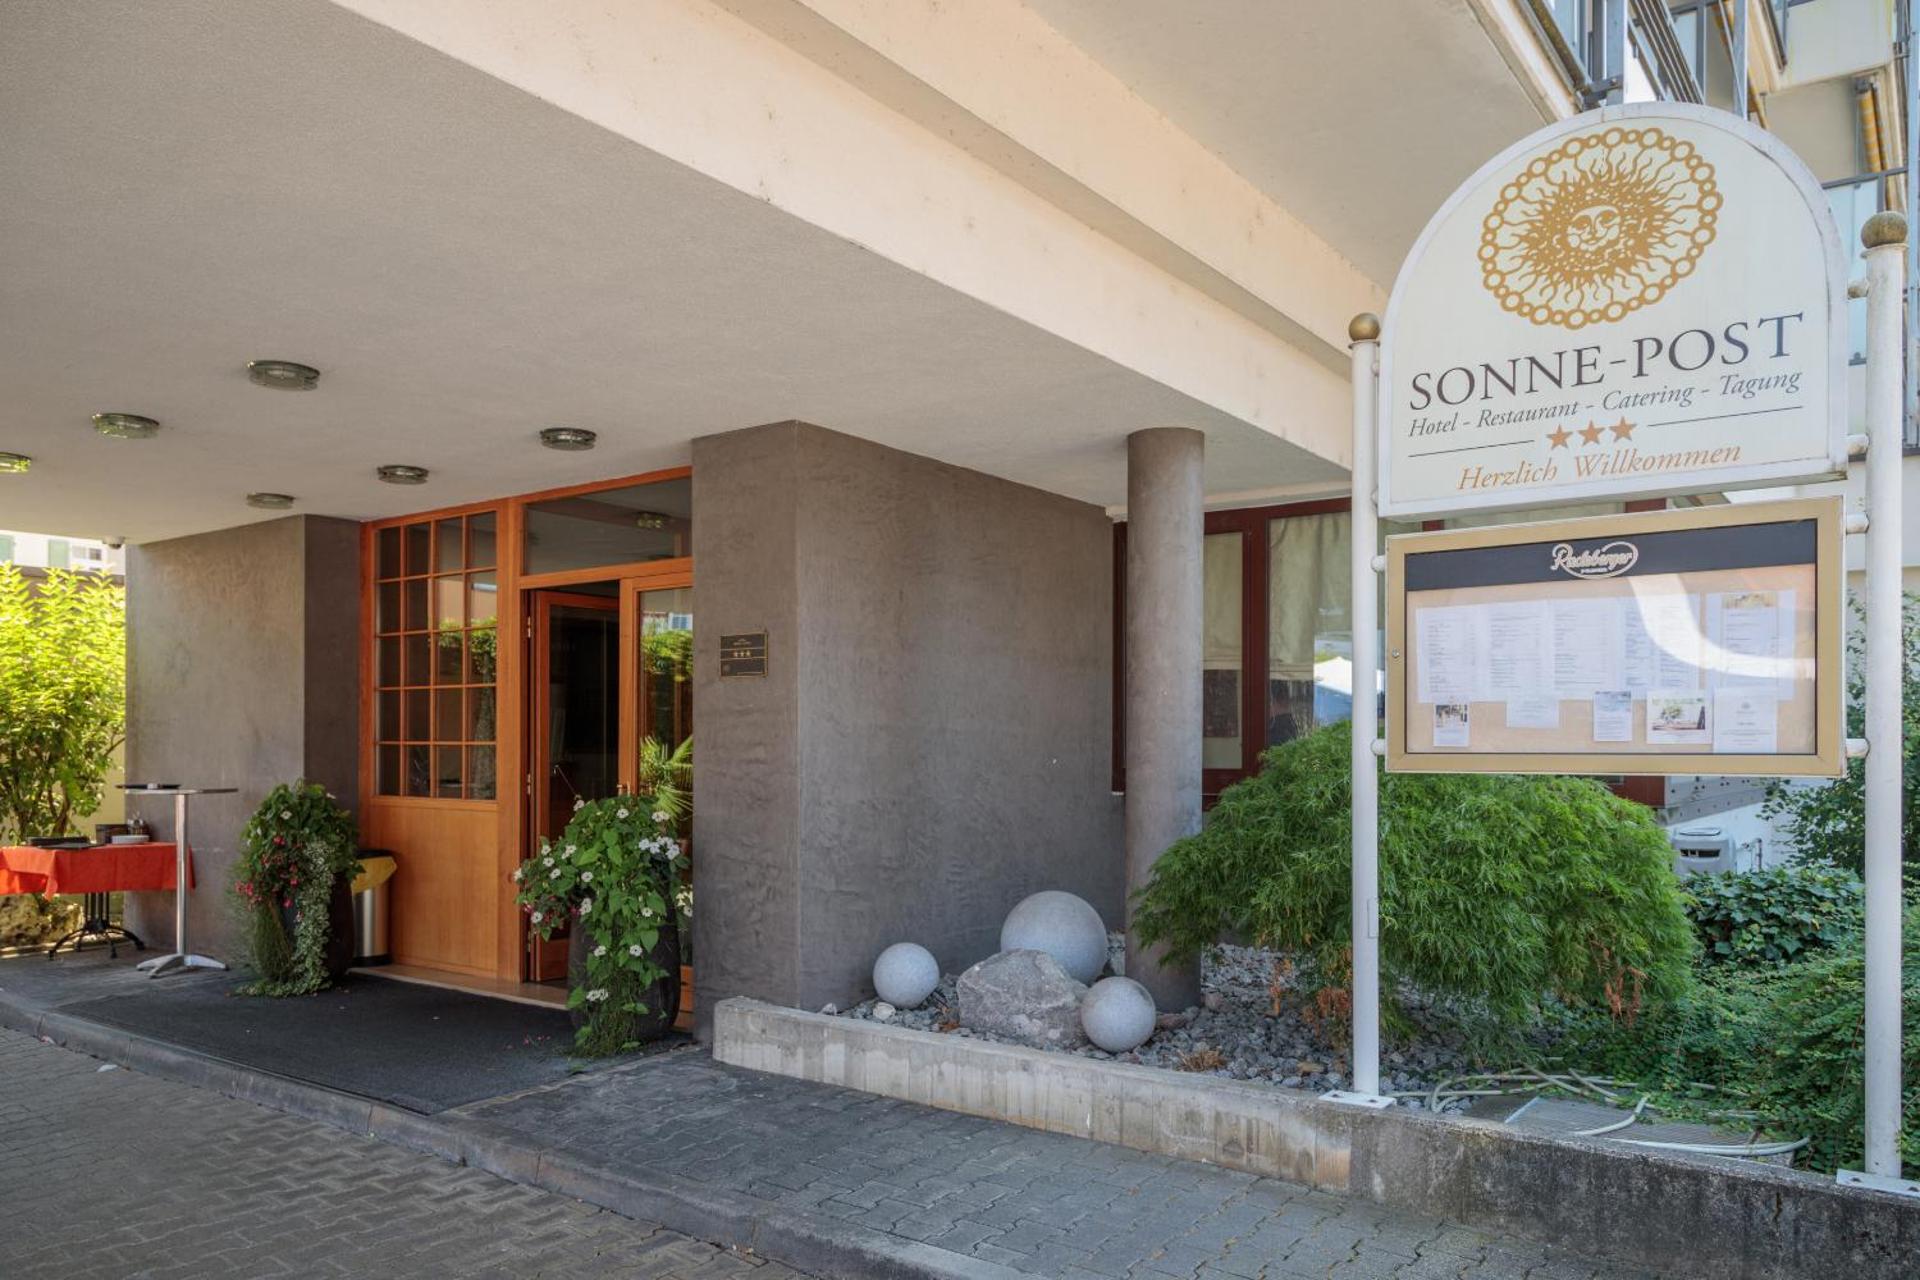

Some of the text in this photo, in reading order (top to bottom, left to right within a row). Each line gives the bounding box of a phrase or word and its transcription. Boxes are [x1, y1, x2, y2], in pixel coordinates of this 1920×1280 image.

[1409, 312, 1804, 411] SONNE-POST
[1408, 412, 1459, 437] Hotel
[1476, 401, 1579, 428] Restaurant
[1602, 385, 1695, 411] Catering
[1719, 371, 1803, 399] Tagung
[1457, 445, 1742, 490] Herzlich Willkommen
